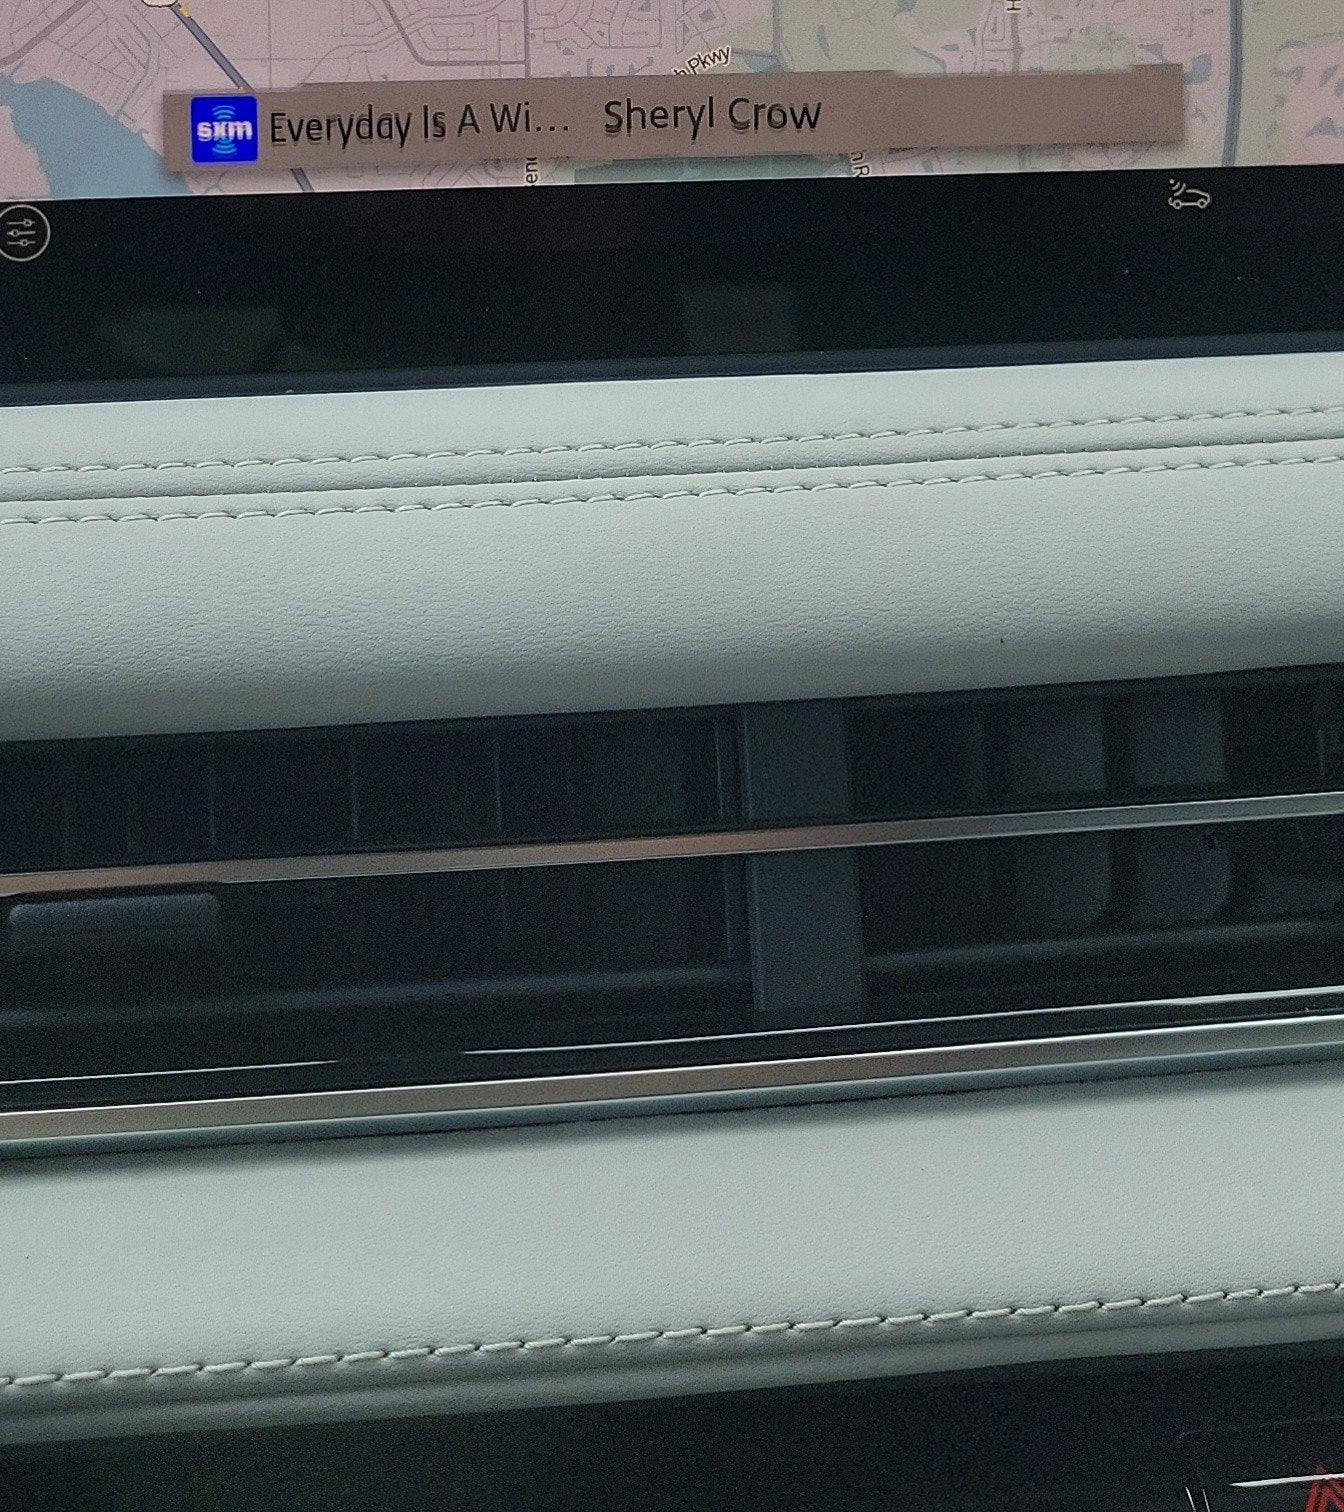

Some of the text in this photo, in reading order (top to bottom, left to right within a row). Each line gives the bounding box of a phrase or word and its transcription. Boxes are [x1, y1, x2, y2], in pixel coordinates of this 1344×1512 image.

[687, 47, 730, 76] Pkwy
[270, 104, 412, 149] Everyday
[422, 104, 446, 139] Is
[457, 104, 481, 136] A
[603, 95, 823, 142] Sheryl Crow
